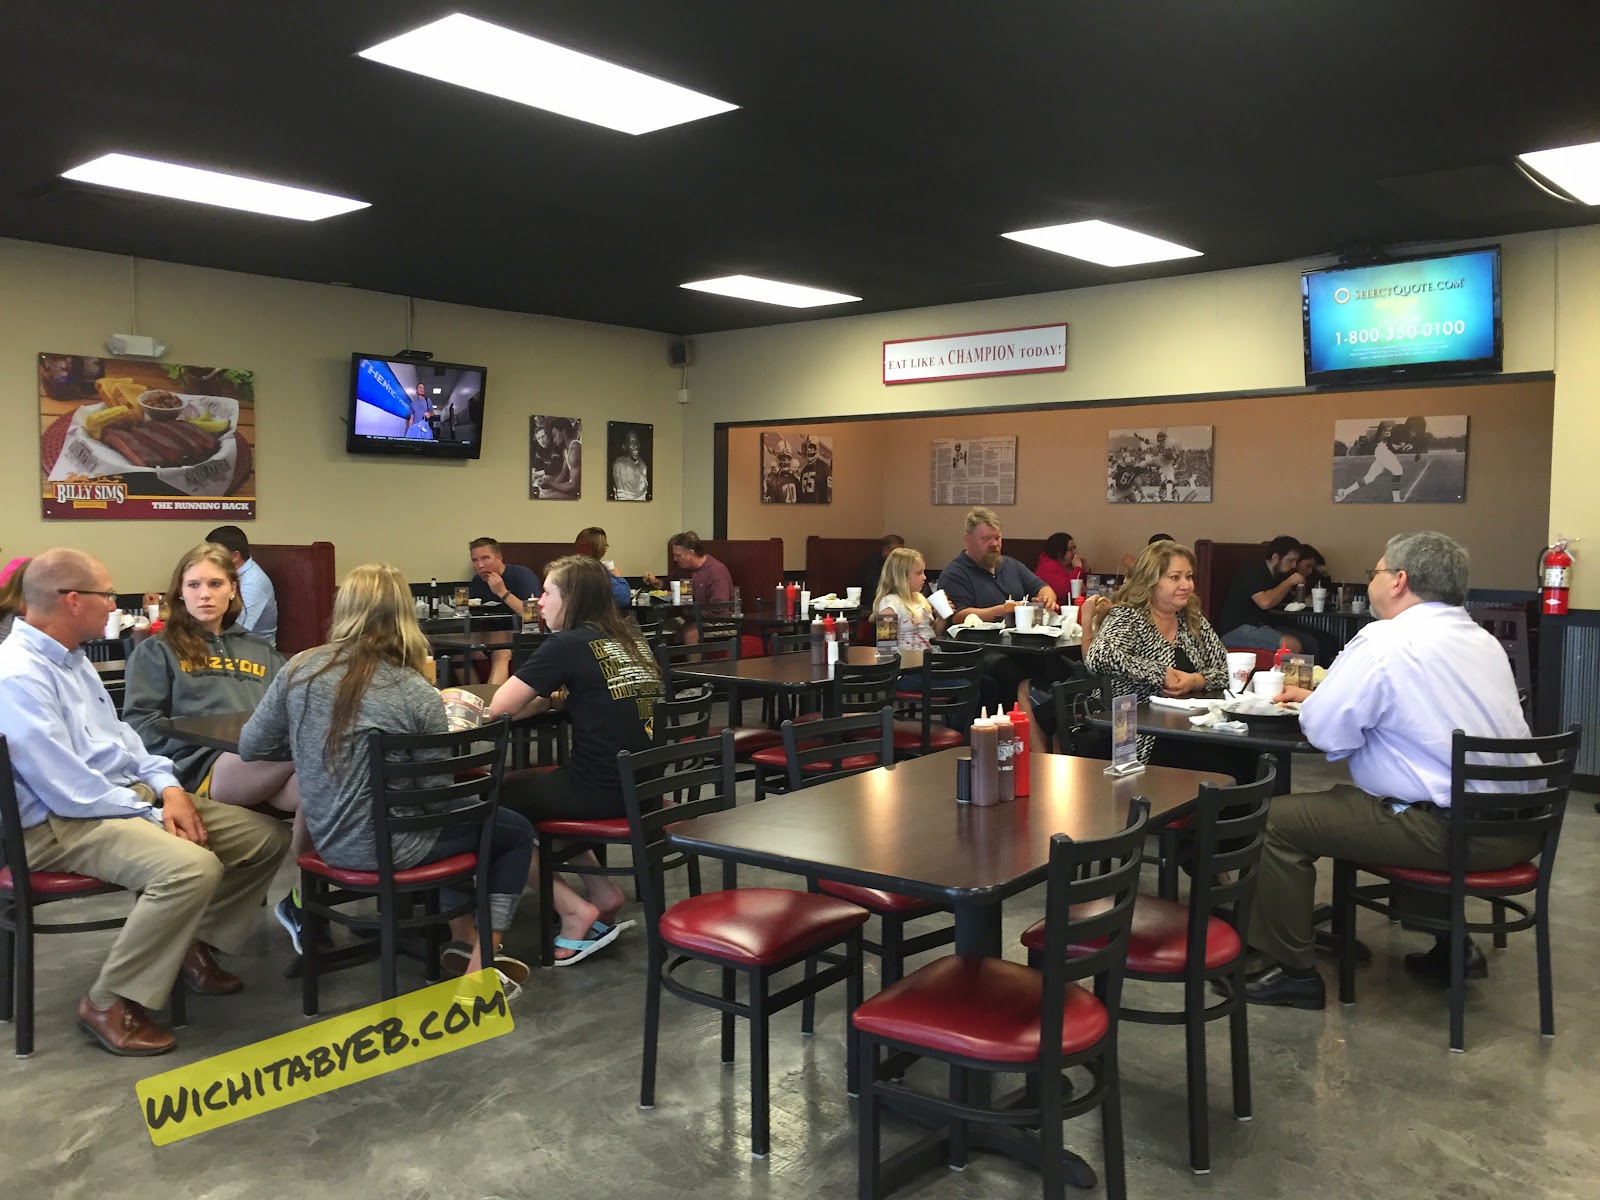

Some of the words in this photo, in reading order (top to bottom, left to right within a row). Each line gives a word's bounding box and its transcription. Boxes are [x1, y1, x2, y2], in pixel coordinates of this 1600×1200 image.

[1335, 320, 1466, 346] 1-800-350-0100
[889, 359, 908, 370] EAT
[910, 357, 935, 369] LIKE
[938, 357, 945, 366] A
[948, 344, 1015, 365] CHAMPION
[1019, 344, 1062, 359] TODAY!
[801, 471, 816, 493] 65
[57, 484, 92, 504] BILLY
[94, 485, 124, 504] SIMS
[151, 502, 173, 510] THE
[174, 502, 221, 510] RUNNING
[221, 502, 249, 510] BACK
